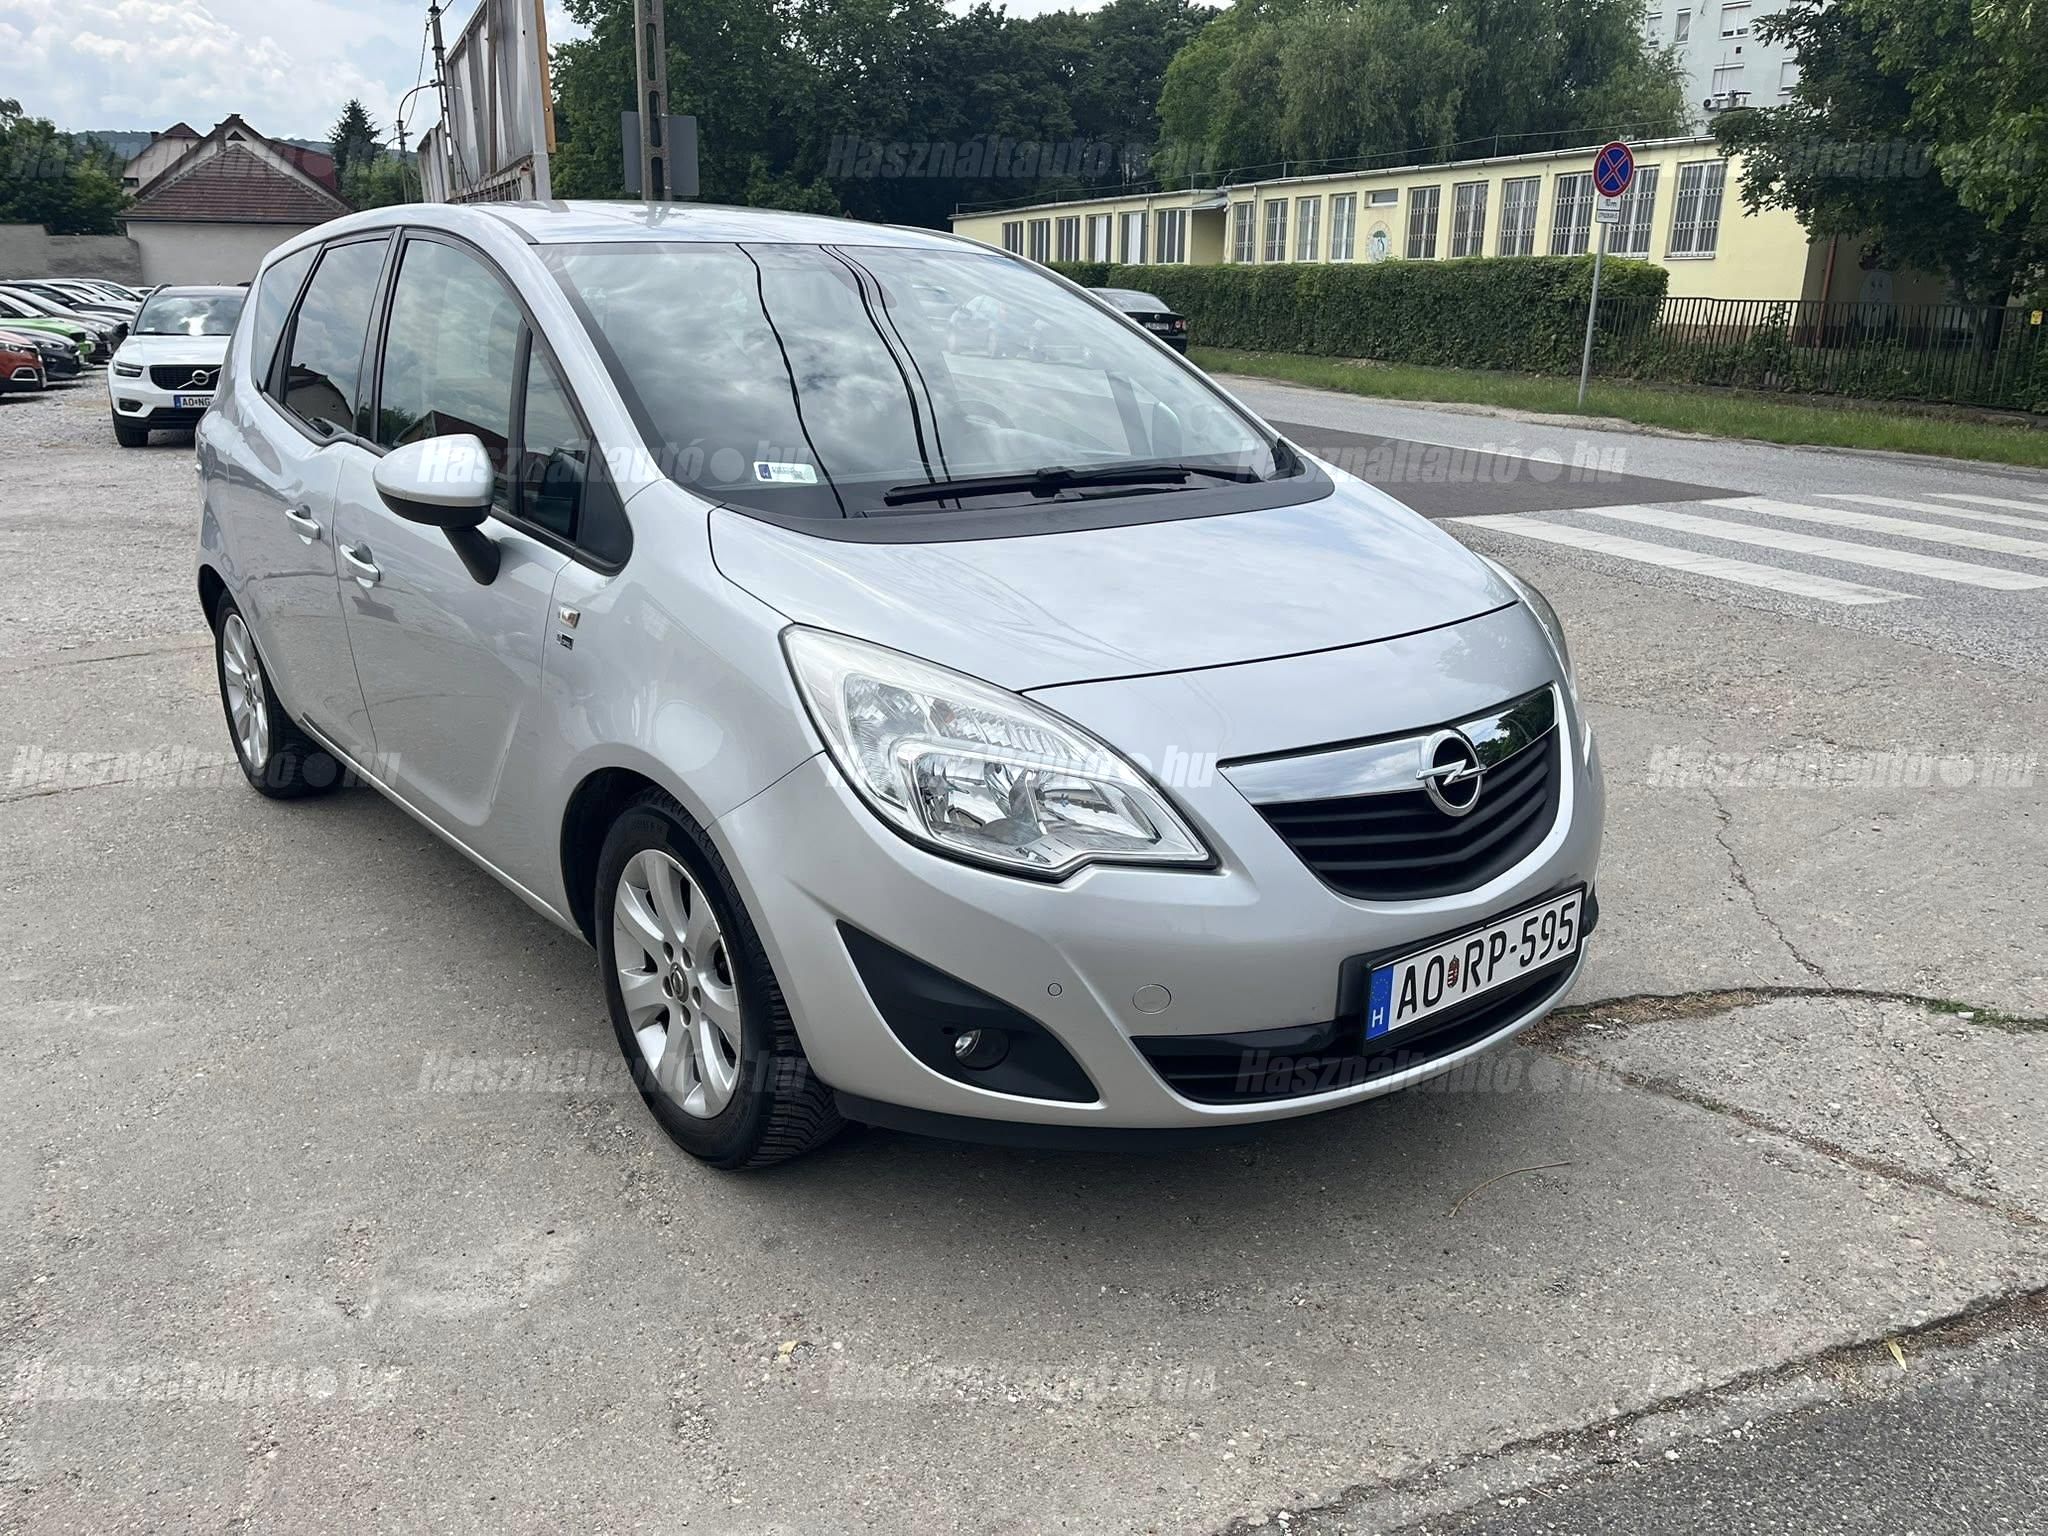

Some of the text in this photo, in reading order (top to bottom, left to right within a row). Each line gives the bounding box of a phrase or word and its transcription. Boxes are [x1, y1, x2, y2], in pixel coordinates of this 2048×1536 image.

[1397, 900, 1576, 1020] AO RP-595
[1371, 1008, 1384, 1028] H
